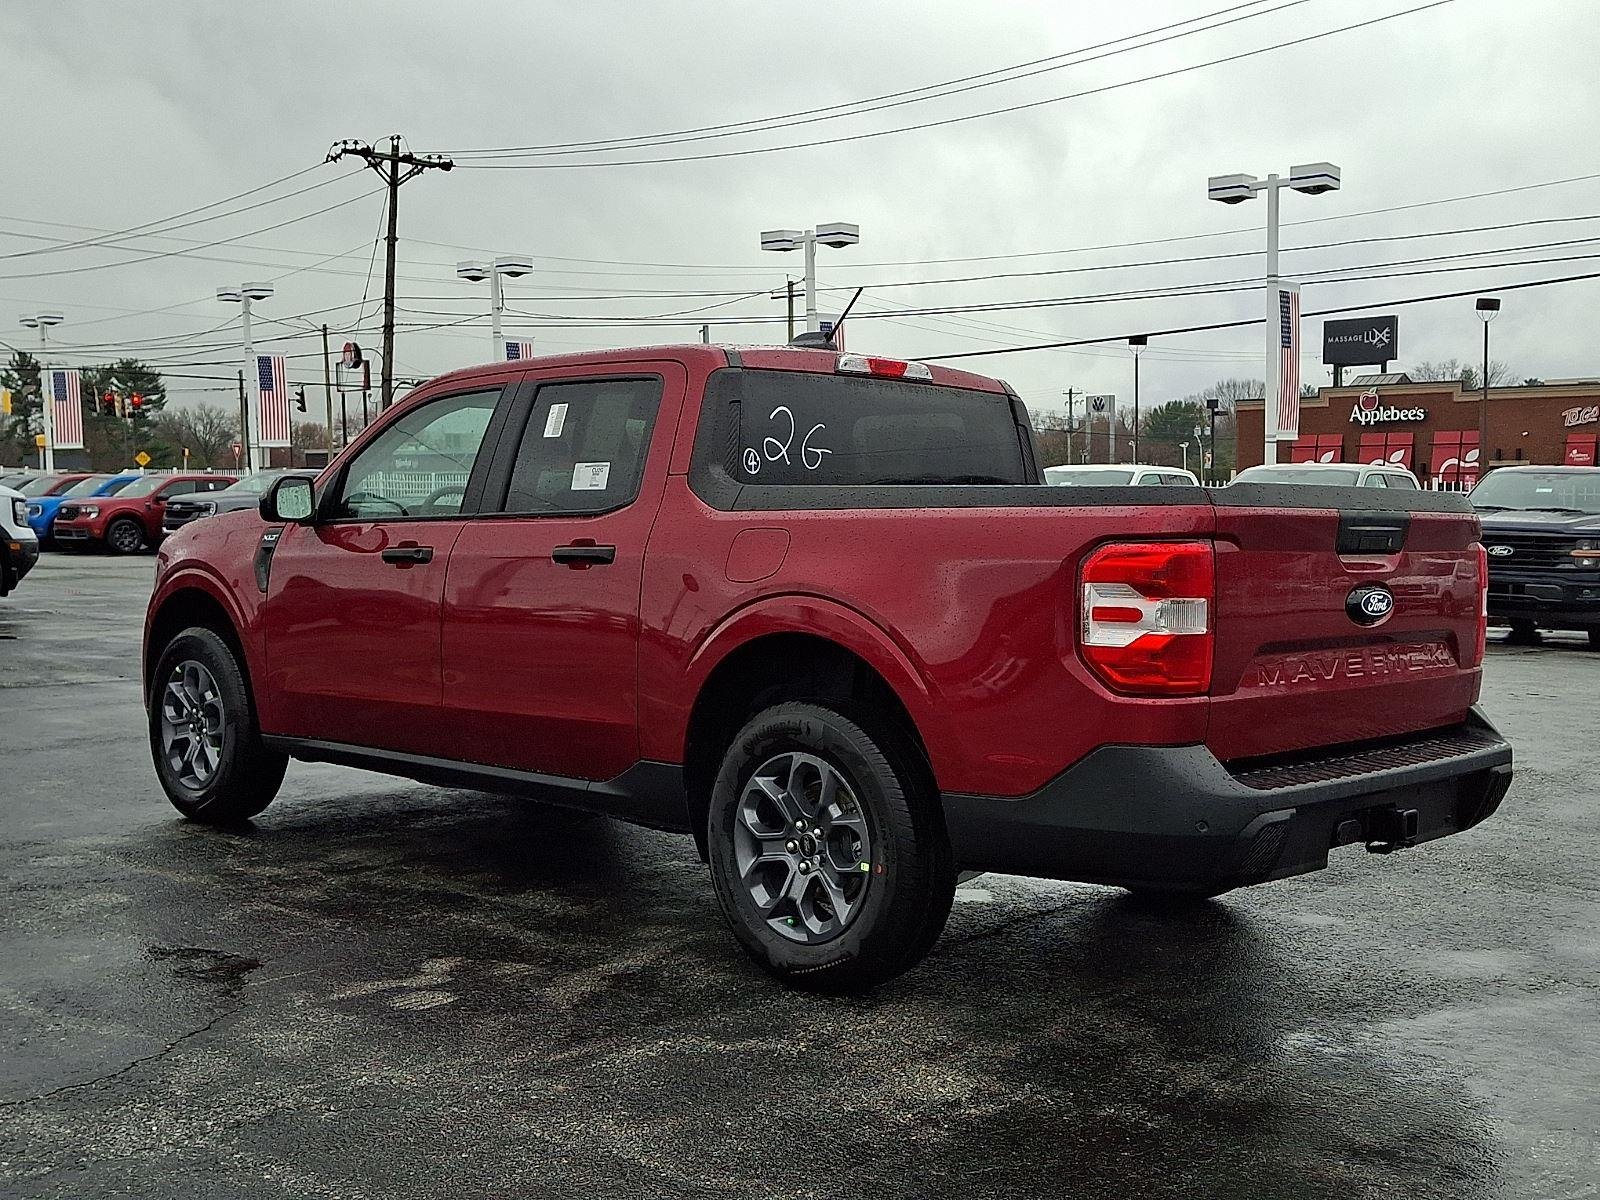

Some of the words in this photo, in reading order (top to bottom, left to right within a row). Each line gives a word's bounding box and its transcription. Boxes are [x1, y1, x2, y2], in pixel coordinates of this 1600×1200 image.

[1327, 334, 1363, 344] MASSAGE
[1349, 404, 1425, 426] Applebee's
[1367, 594, 1388, 612] Ford
